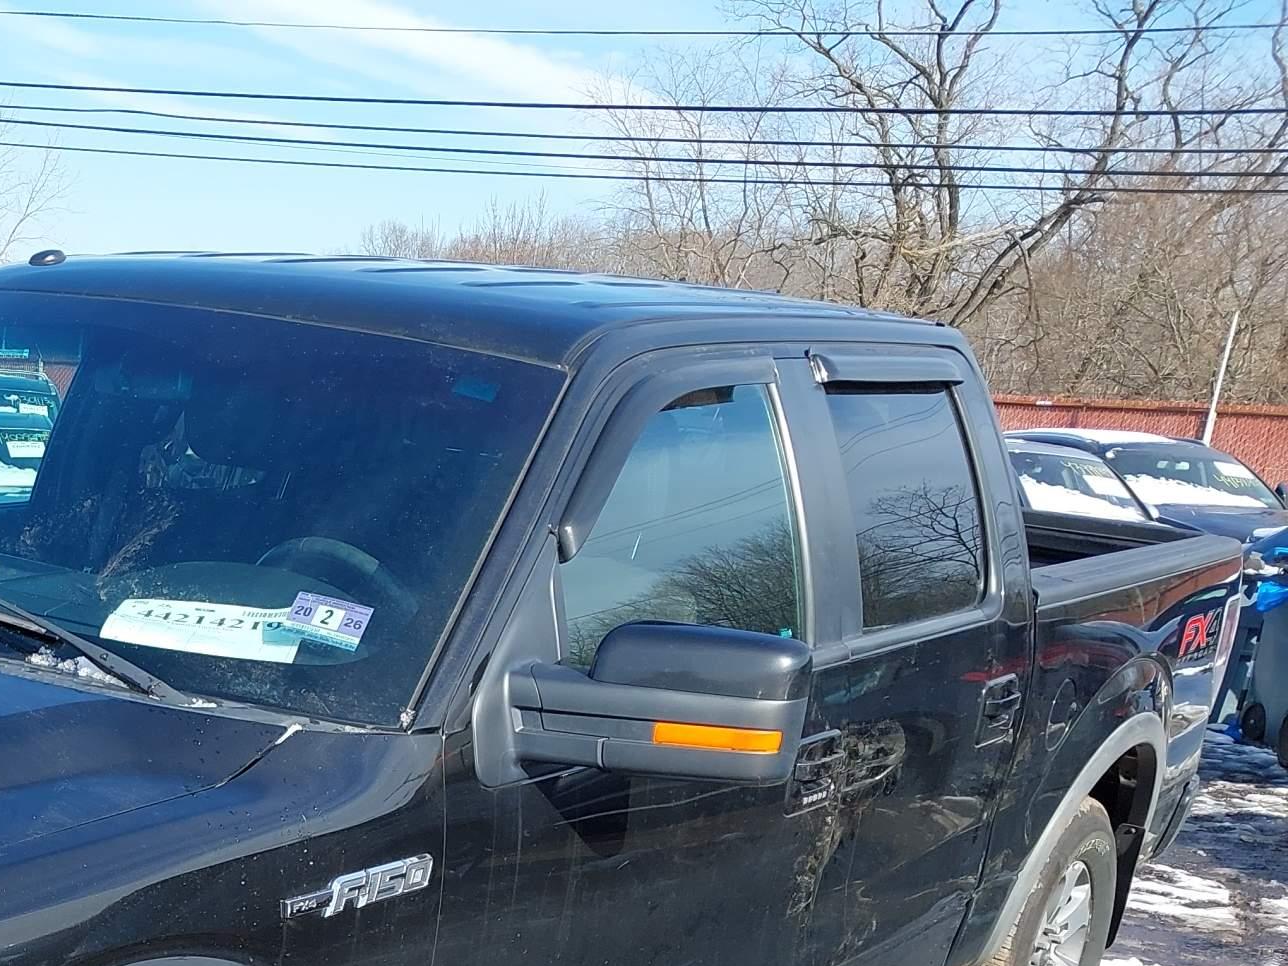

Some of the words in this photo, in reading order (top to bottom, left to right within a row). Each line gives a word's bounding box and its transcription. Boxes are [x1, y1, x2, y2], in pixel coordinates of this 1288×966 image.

[137, 609, 284, 632] 44214219
[294, 605, 313, 617] 20
[319, 609, 334, 625] 2
[343, 617, 363, 630] 26
[1178, 606, 1223, 658] FX4
